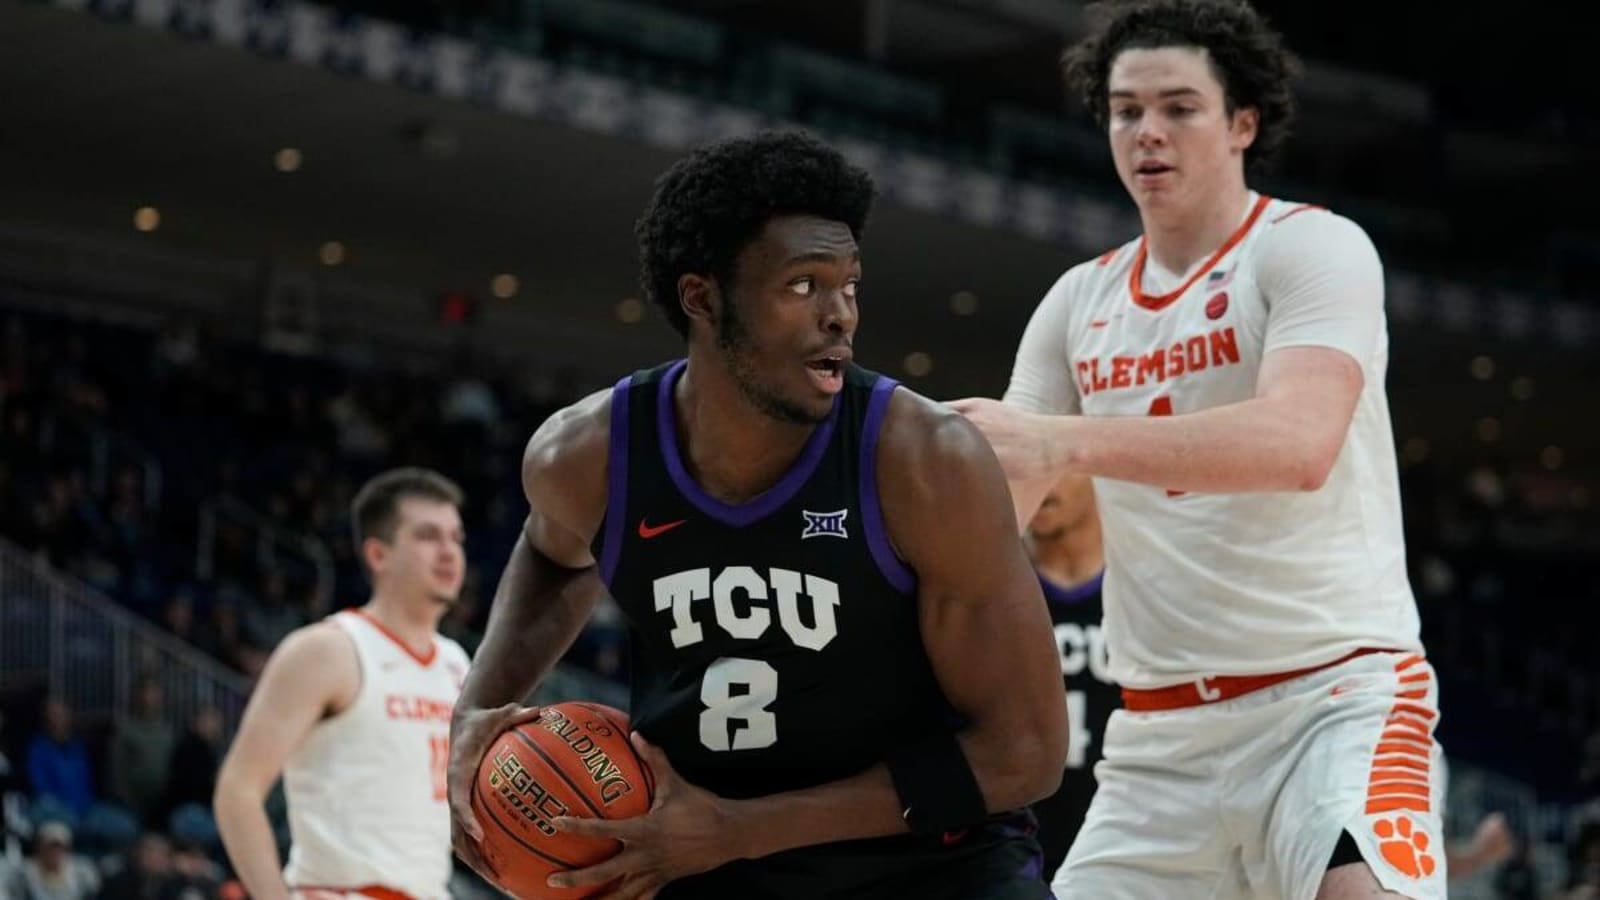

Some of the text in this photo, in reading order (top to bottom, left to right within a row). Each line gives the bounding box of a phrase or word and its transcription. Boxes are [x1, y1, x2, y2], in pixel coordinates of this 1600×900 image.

[1076, 327, 1240, 396] CLEMSON
[652, 566, 841, 652] TCU
[699, 656, 779, 752] 8
[494, 744, 569, 821] LEGAC
[538, 708, 634, 806] PALDING
